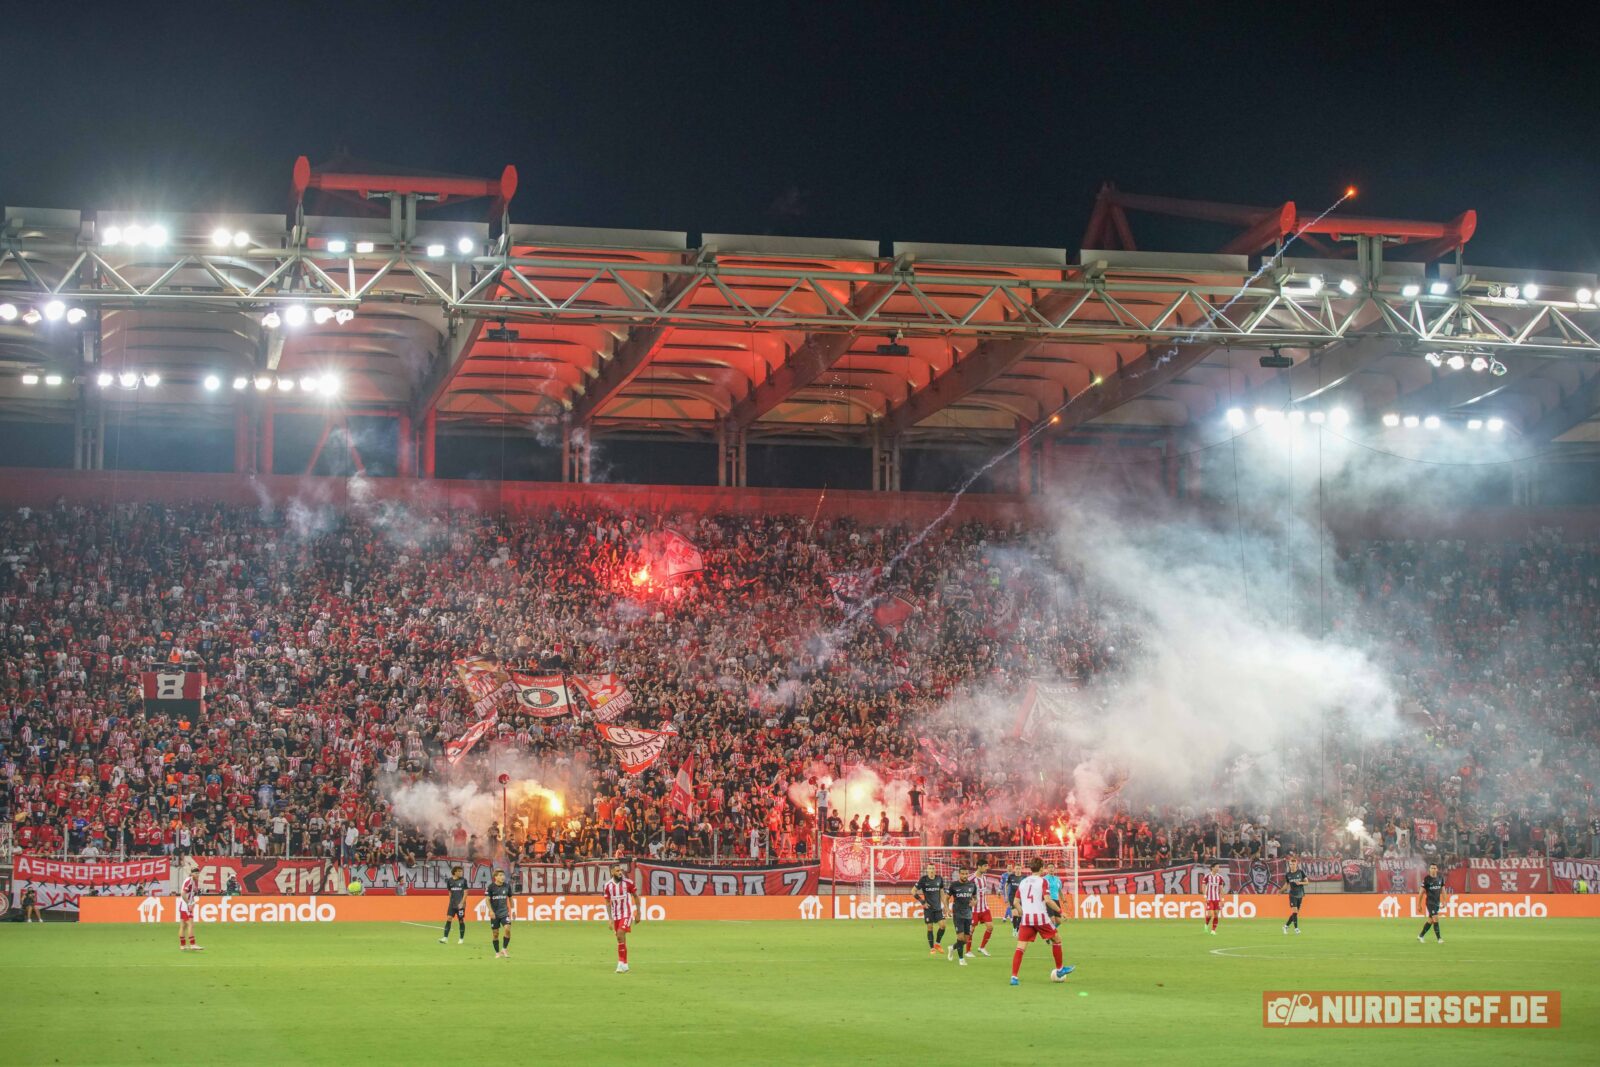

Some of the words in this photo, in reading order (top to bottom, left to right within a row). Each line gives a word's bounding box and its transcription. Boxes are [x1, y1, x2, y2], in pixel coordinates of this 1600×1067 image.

[18, 857, 167, 881] ASPROPIRGOS
[783, 871, 808, 896] 7
[1027, 884, 1034, 904] 4
[510, 896, 666, 921] Lieferado
[1114, 894, 1257, 919] Lieferado
[1410, 895, 1547, 918] Leferando
